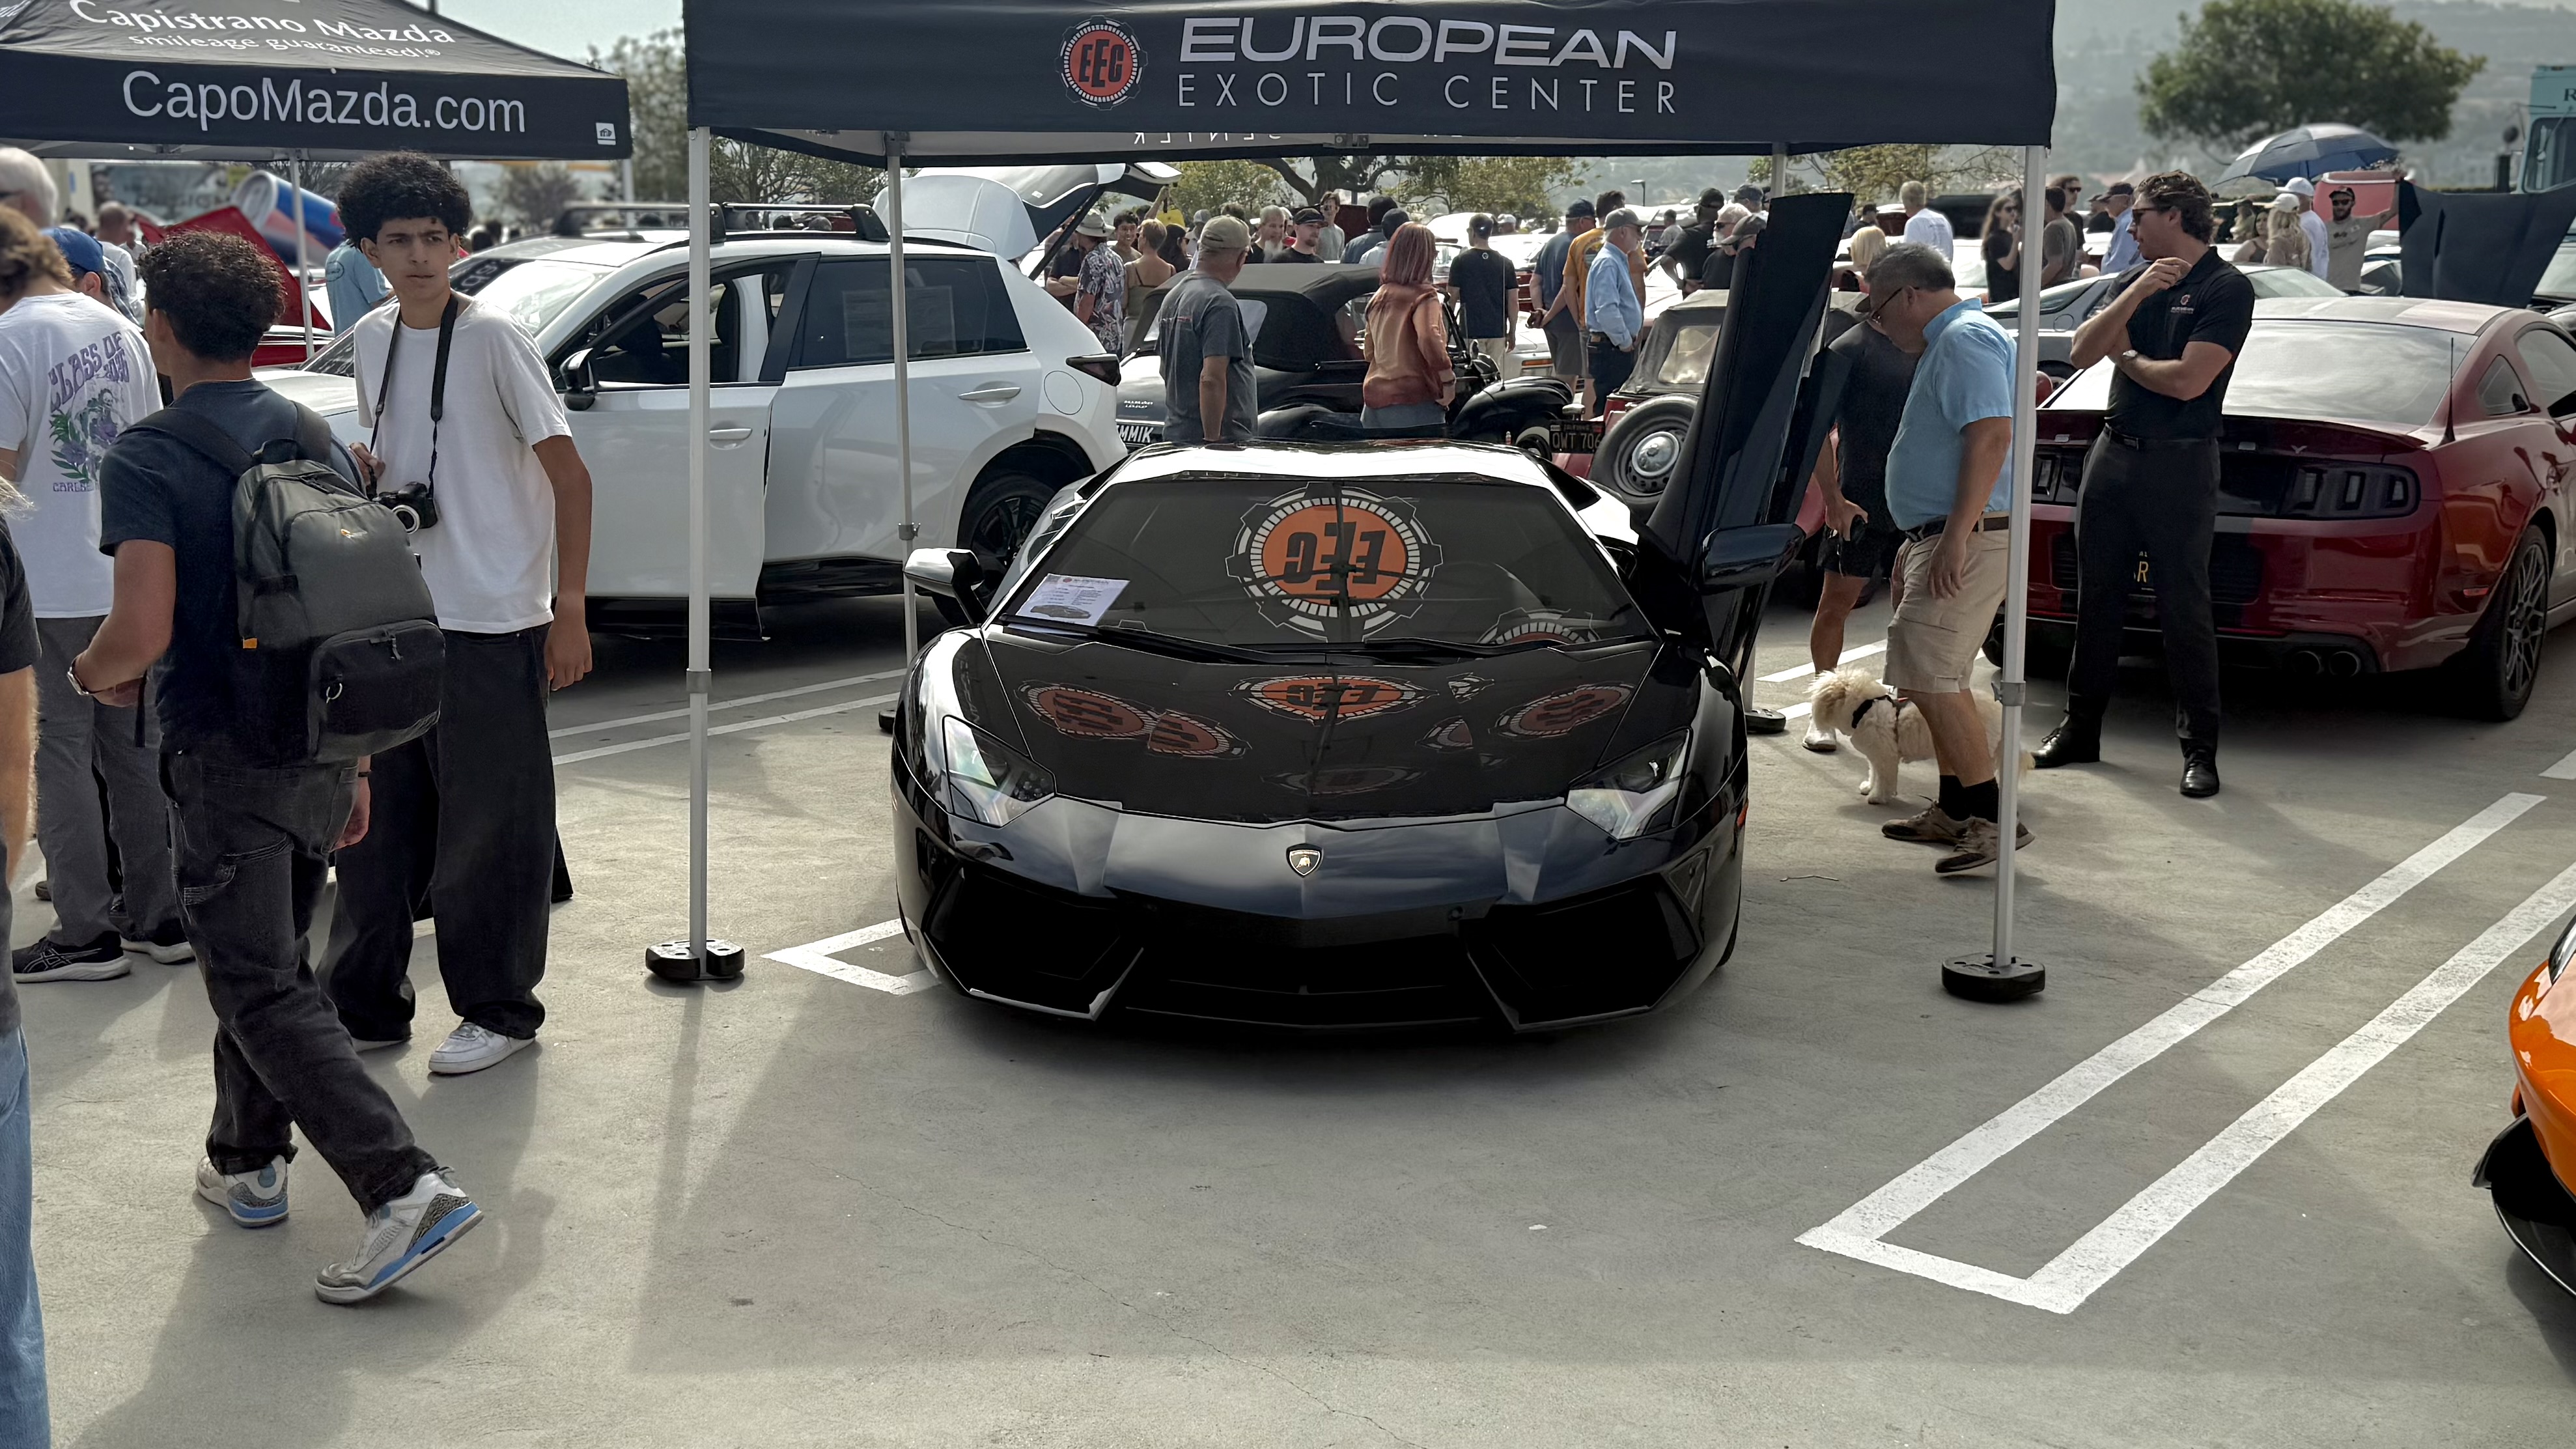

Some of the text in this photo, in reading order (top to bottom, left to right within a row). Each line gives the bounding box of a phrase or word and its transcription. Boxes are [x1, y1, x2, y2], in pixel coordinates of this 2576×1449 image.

[69, 0, 456, 43] Capistrano Mazda
[128, 35, 259, 49] smileage
[1179, 16, 1677, 70] EUROPEAN
[1078, 38, 1125, 88] EEC
[122, 70, 525, 133] CapoMazda.com
[1178, 72, 1675, 114] EXOTIC CENTER
[48, 331, 122, 412] CLASS OF
[1116, 425, 1154, 443] MMIK
